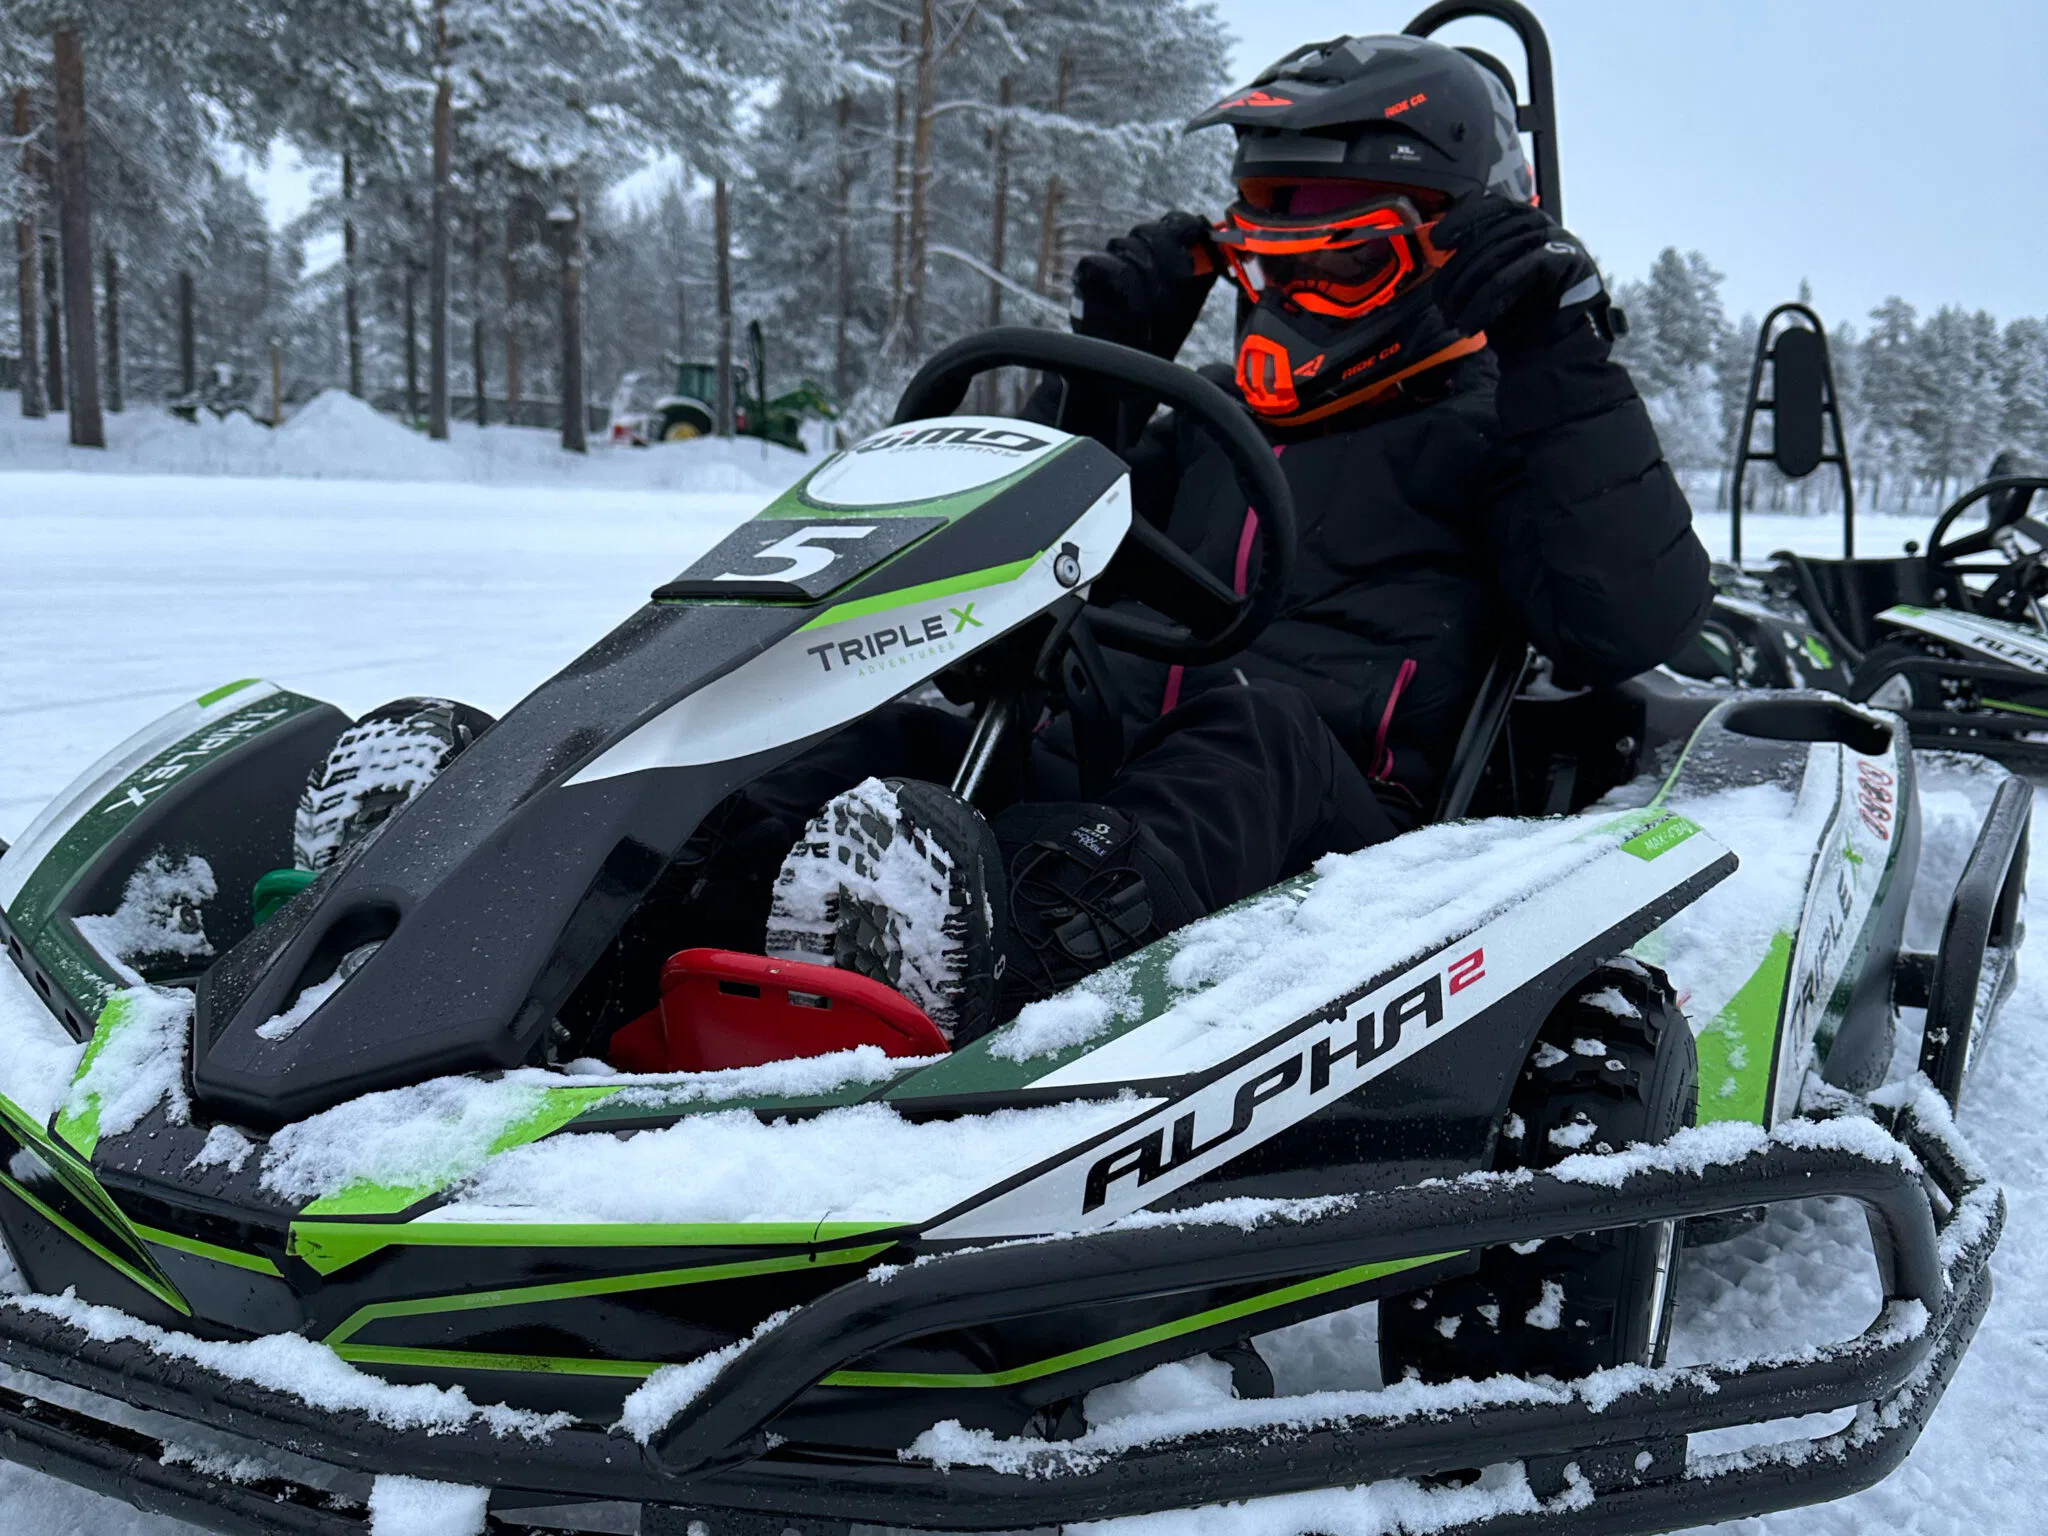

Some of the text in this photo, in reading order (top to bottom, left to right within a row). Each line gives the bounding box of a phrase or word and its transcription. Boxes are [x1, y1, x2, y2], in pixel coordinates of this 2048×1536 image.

[1342, 355, 1377, 380] RIDE
[713, 526, 878, 583] 5
[857, 641, 956, 677] ADVENTURES
